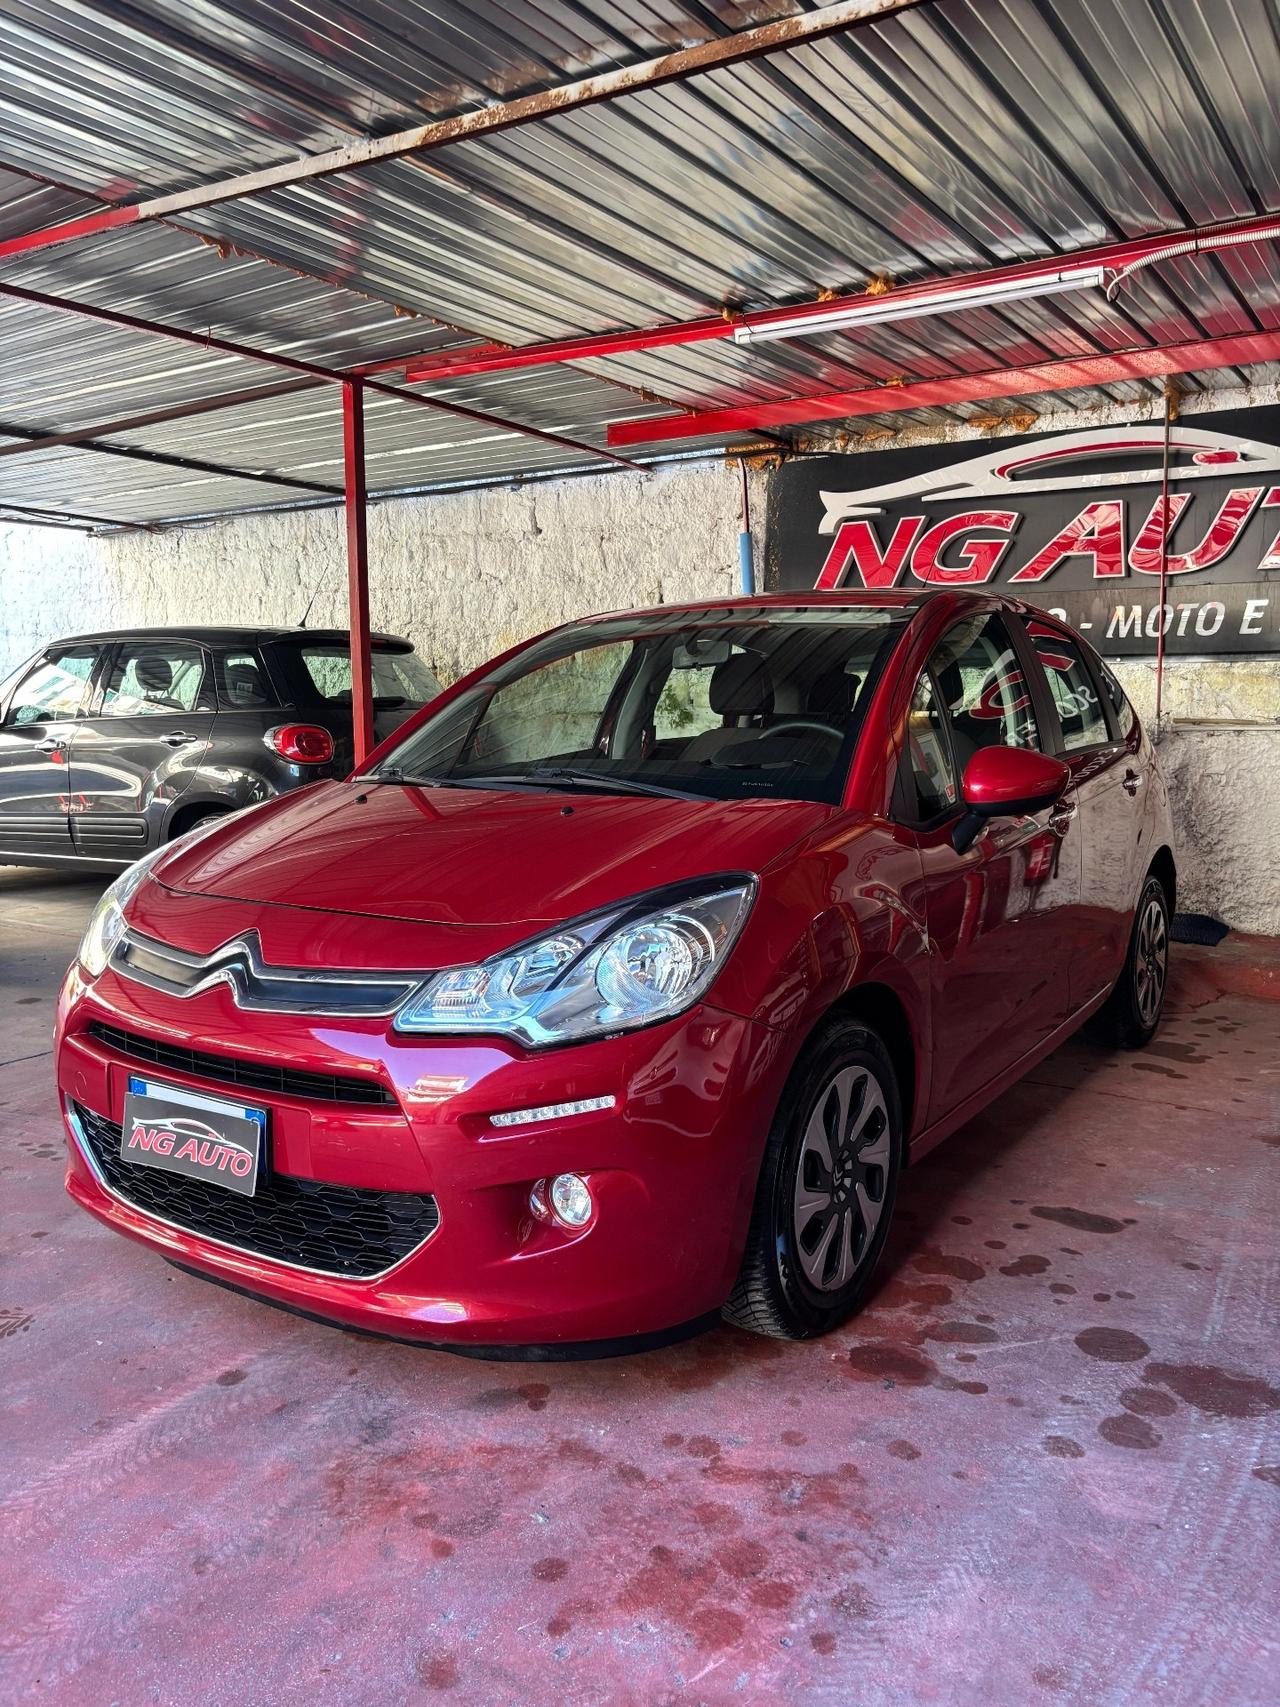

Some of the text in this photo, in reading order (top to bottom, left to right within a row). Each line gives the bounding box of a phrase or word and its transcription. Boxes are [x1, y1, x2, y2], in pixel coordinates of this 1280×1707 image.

[813, 510, 1022, 590] NG
[1105, 601, 1226, 639] MOTO
[1238, 598, 1270, 636] E
[128, 1126, 253, 1177] NG AUTO
